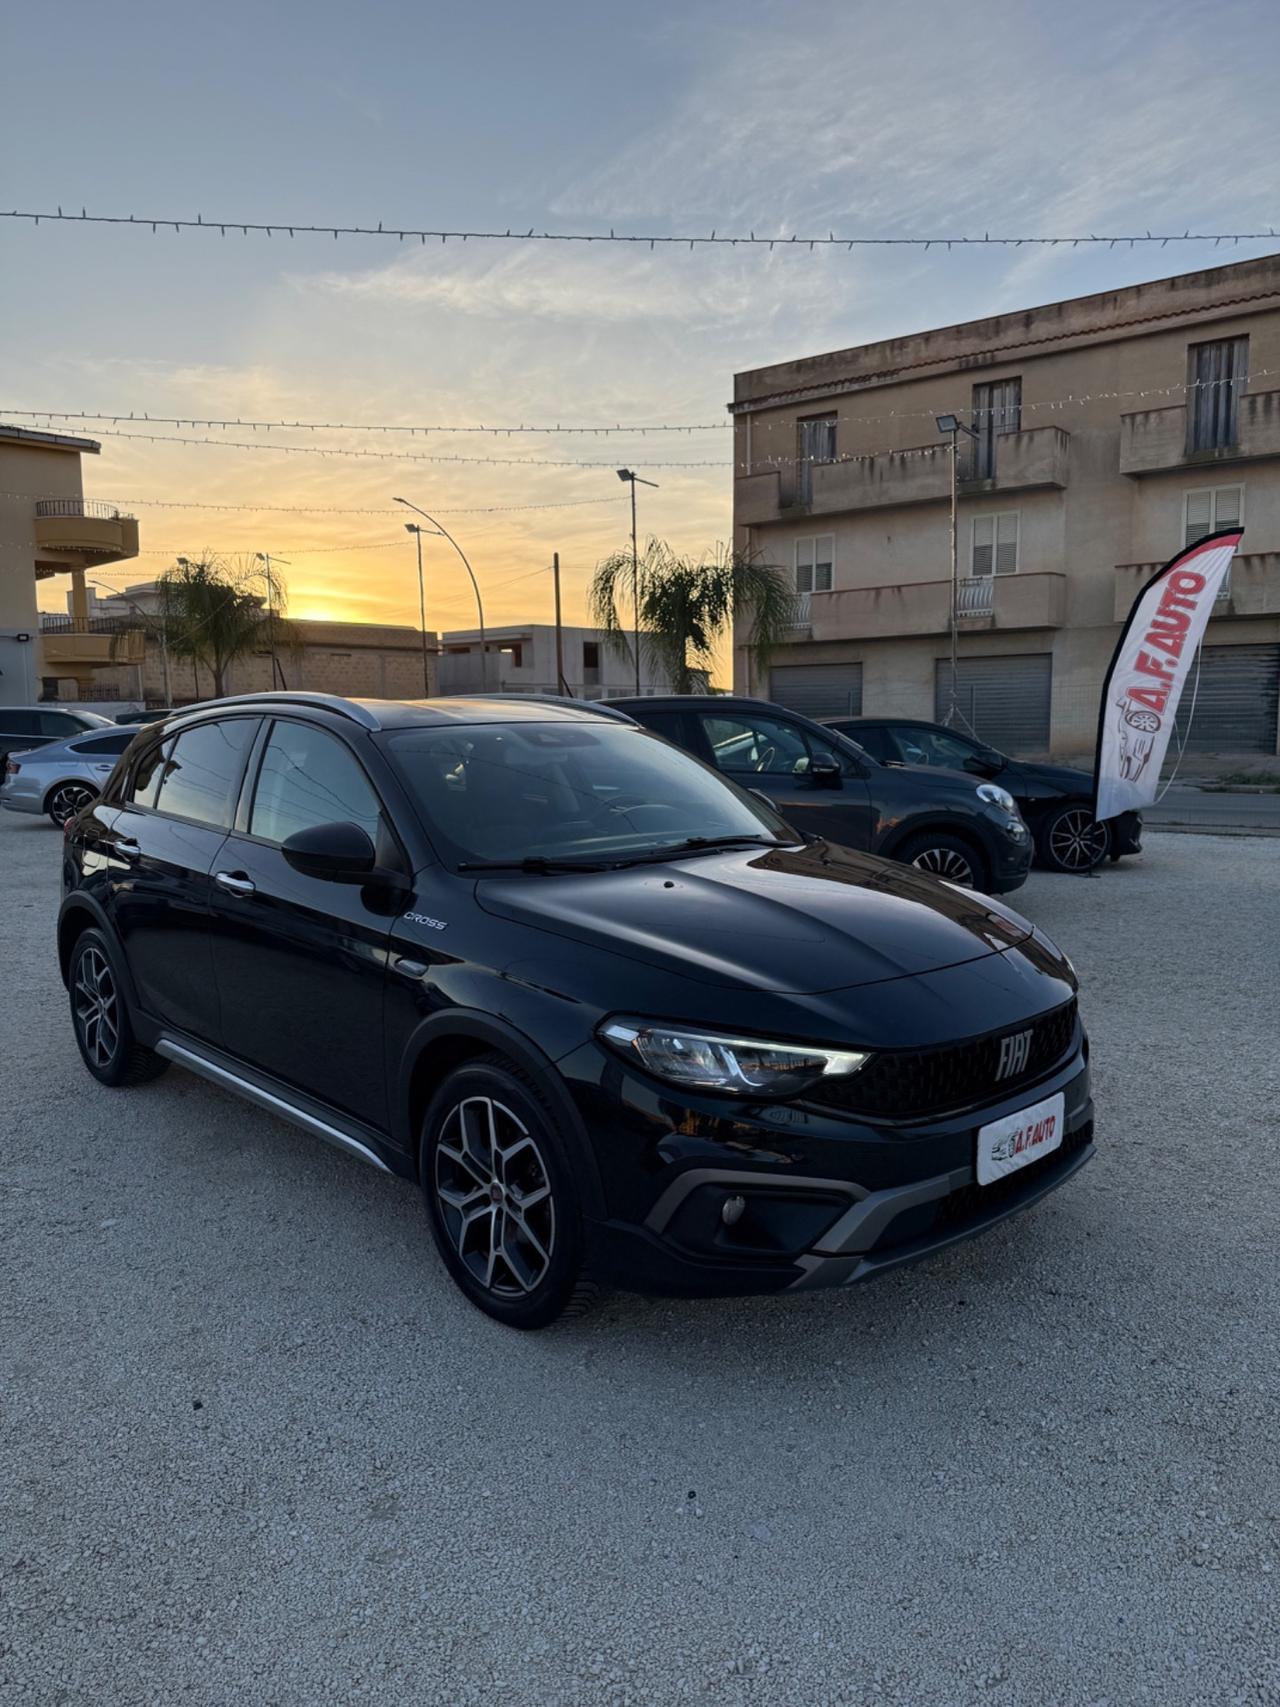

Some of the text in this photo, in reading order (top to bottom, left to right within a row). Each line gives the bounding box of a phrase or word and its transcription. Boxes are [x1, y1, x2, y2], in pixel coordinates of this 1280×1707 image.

[1125, 570, 1206, 716] A.F.AUTO
[403, 911, 448, 930] CROSS
[994, 1029, 1033, 1082] FIAT
